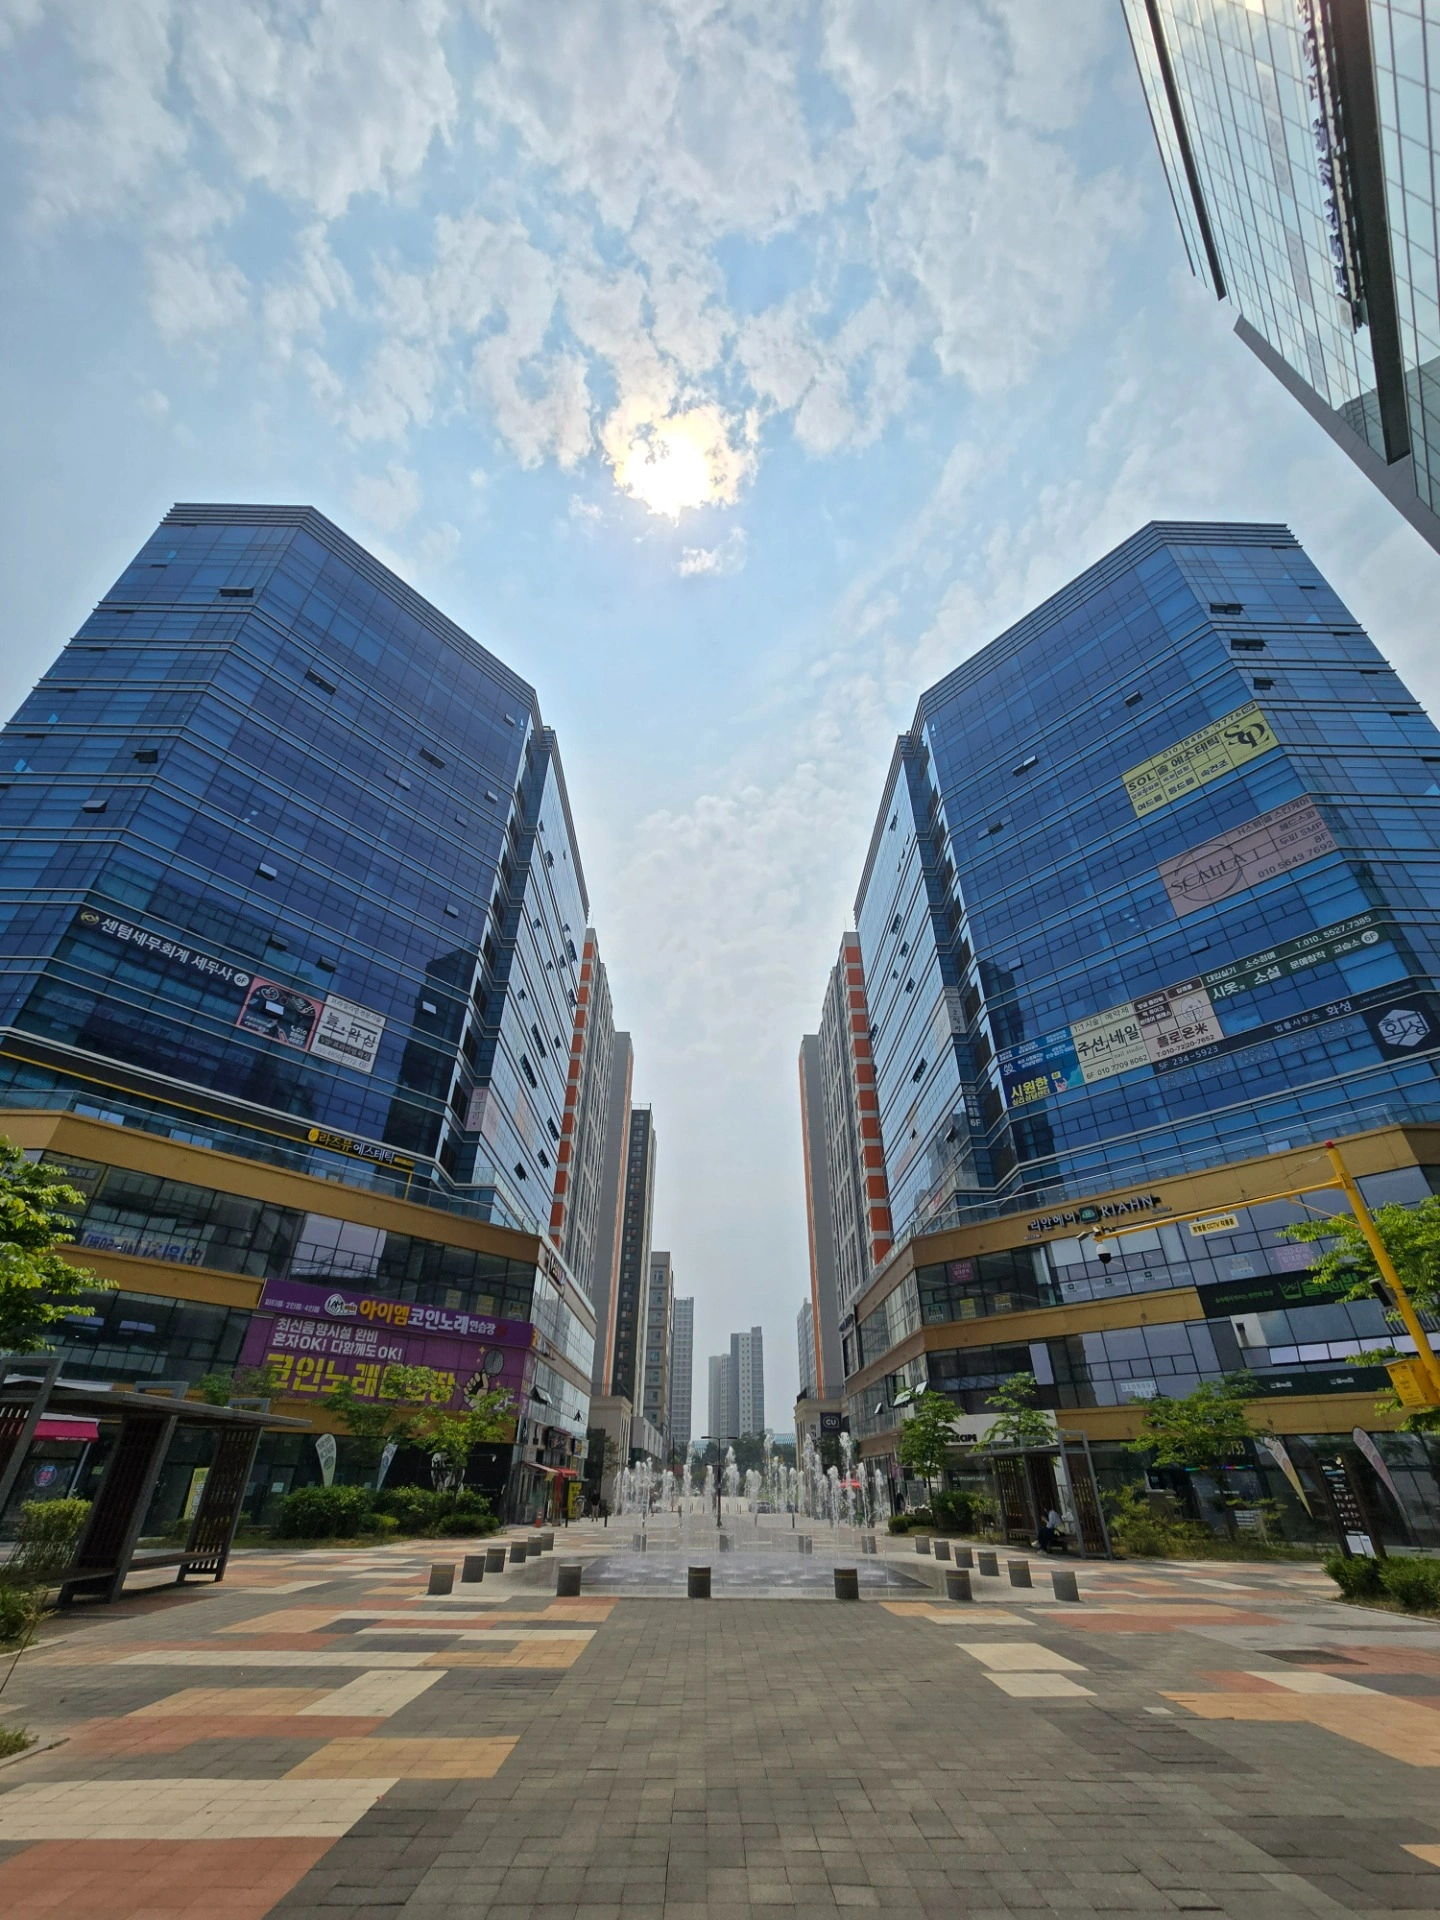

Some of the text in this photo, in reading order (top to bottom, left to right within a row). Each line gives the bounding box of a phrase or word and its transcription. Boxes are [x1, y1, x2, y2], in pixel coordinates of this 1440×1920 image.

[1127, 771, 1157, 792] SOL
[1169, 734, 1222, 768] 에스테틱
[1199, 758, 1230, 779] 속건조
[1278, 809, 1317, 833] 헤드스파
[1299, 821, 1324, 838] SMP
[1313, 831, 1330, 844] 8F
[1257, 839, 1336, 880] 010 5643 7692
[101, 918, 190, 964] 센텀세무회계
[235, 973, 248, 984] 6F
[1251, 965, 1283, 986] 소설
[1332, 937, 1362, 955] 교습소
[1363, 931, 1377, 943] 6F
[1104, 1006, 1130, 1021] 예약제
[1273, 1011, 1321, 1034] 법률사무소
[1324, 998, 1354, 1019] 화성
[358, 1058, 369, 1070] 6F
[1113, 1050, 1126, 1059] nail
[1086, 1071, 1095, 1080] 6F
[1096, 1066, 1111, 1077] 010
[1110, 1060, 1129, 1072] 7709
[1157, 1060, 1170, 1071] 5F
[1008, 1075, 1050, 1099] 시원한
[970, 1118, 981, 1127] 6F
[352, 1142, 395, 1165] 에스테틱
[1030, 1211, 1077, 1232] 리안헤어
[1100, 1195, 1155, 1218] RIAHN
[1207, 1221, 1220, 1230] CCTV
[276, 1317, 379, 1344] 최신음향시설 완비
[271, 1331, 328, 1352] 혼자OK!
